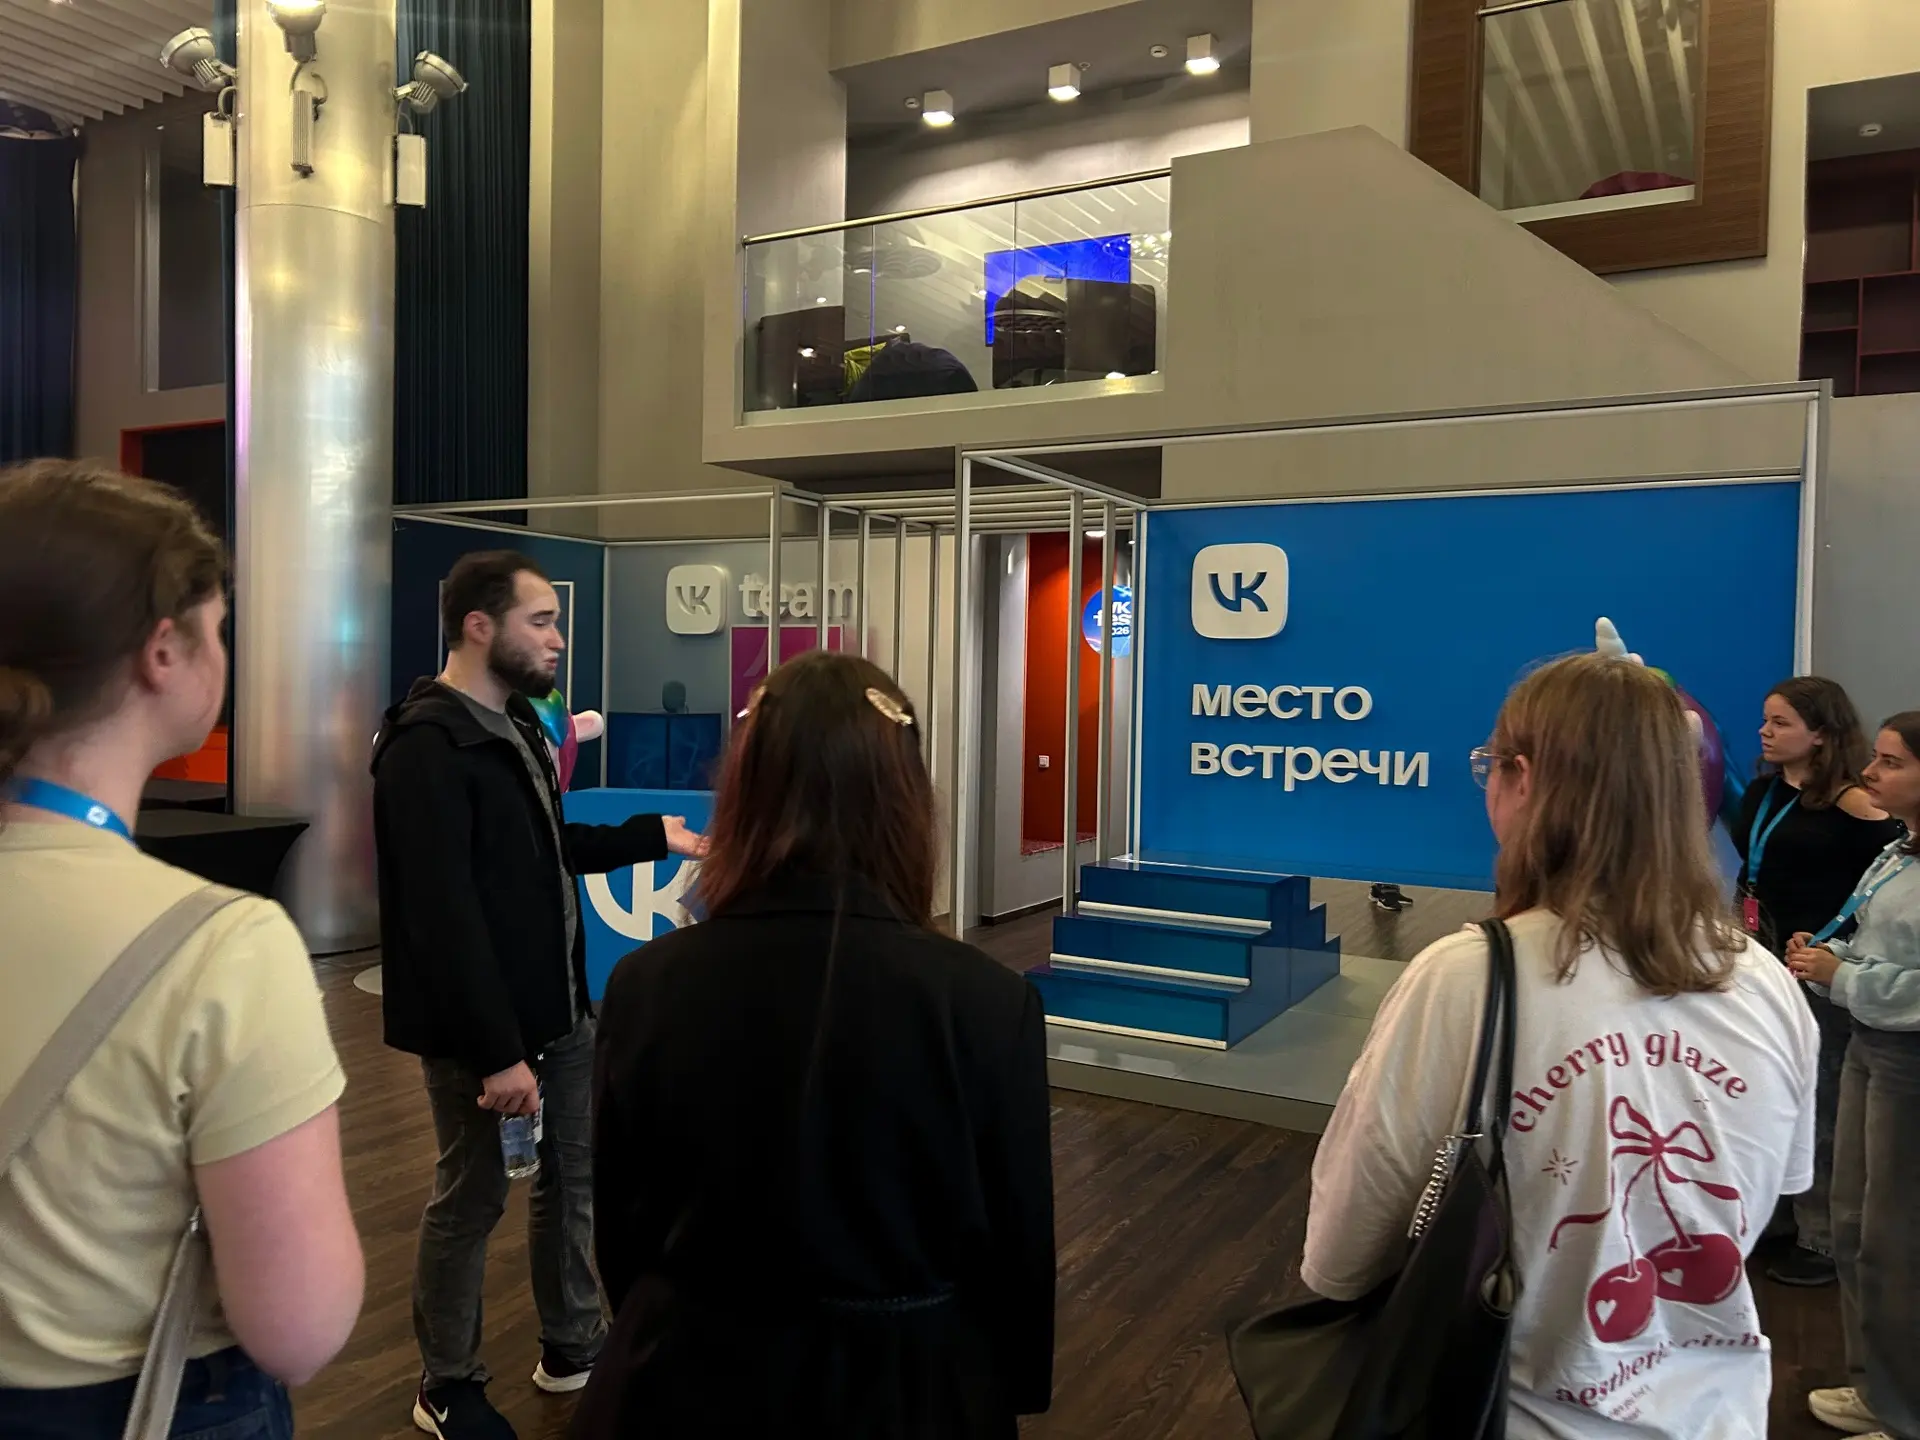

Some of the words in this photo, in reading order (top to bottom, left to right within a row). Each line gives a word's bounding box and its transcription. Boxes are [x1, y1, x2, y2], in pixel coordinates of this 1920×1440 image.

[675, 585, 711, 614] VK
[739, 574, 858, 618] team
[1208, 571, 1269, 612] VK
[1191, 683, 1373, 720] место
[1191, 742, 1429, 791] встречи
[1510, 1032, 1629, 1132] cherry
[1645, 1029, 1747, 1099] glaze
